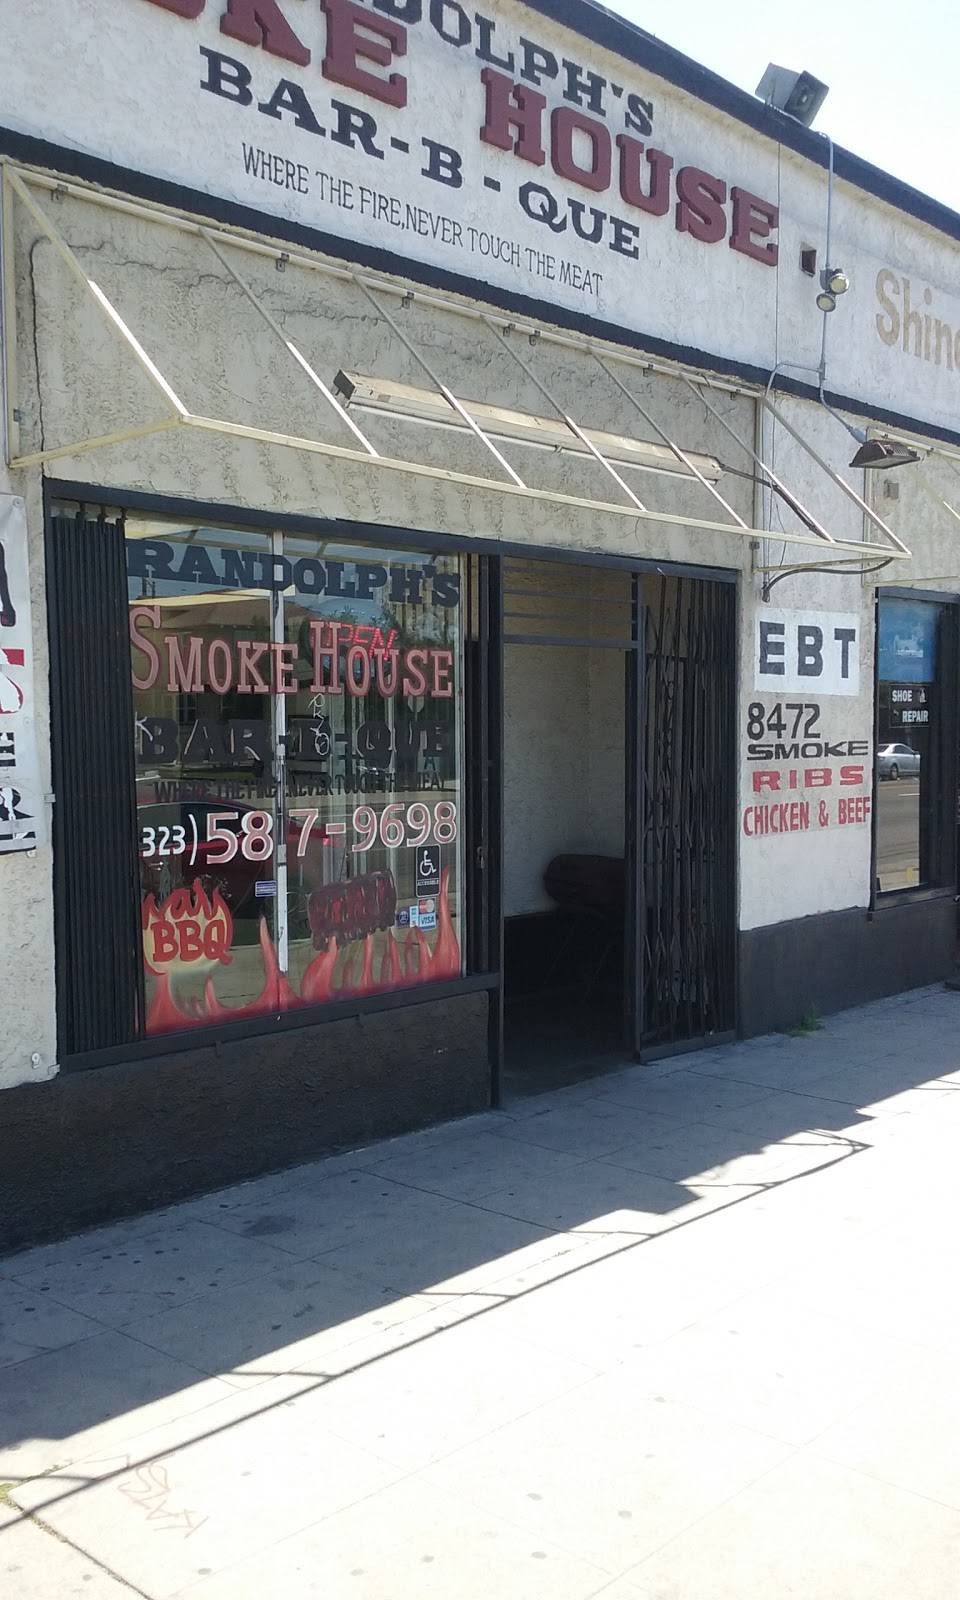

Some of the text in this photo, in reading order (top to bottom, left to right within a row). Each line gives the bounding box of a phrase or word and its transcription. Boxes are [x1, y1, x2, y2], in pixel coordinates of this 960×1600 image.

[479, 67, 779, 267] HOUSE
[241, 142, 309, 195] WHERE
[315, 170, 354, 210] THE
[467, 226, 521, 267] TOUCH
[525, 247, 556, 280] THE
[559, 260, 603, 296] MEAT
[124, 538, 461, 608] RANDOLPH'S
[129, 605, 454, 697] SMOKE HOUSE
[758, 620, 857, 679] EBT
[891, 689, 913, 702] SHOE
[901, 710, 929, 723] REPAIR
[746, 701, 822, 741] 8472
[746, 740, 869, 761] SMOKE
[752, 765, 865, 793] RIBS
[743, 796, 871, 837] CHICKEN & BEEF
[150, 919, 233, 965] BBQ
